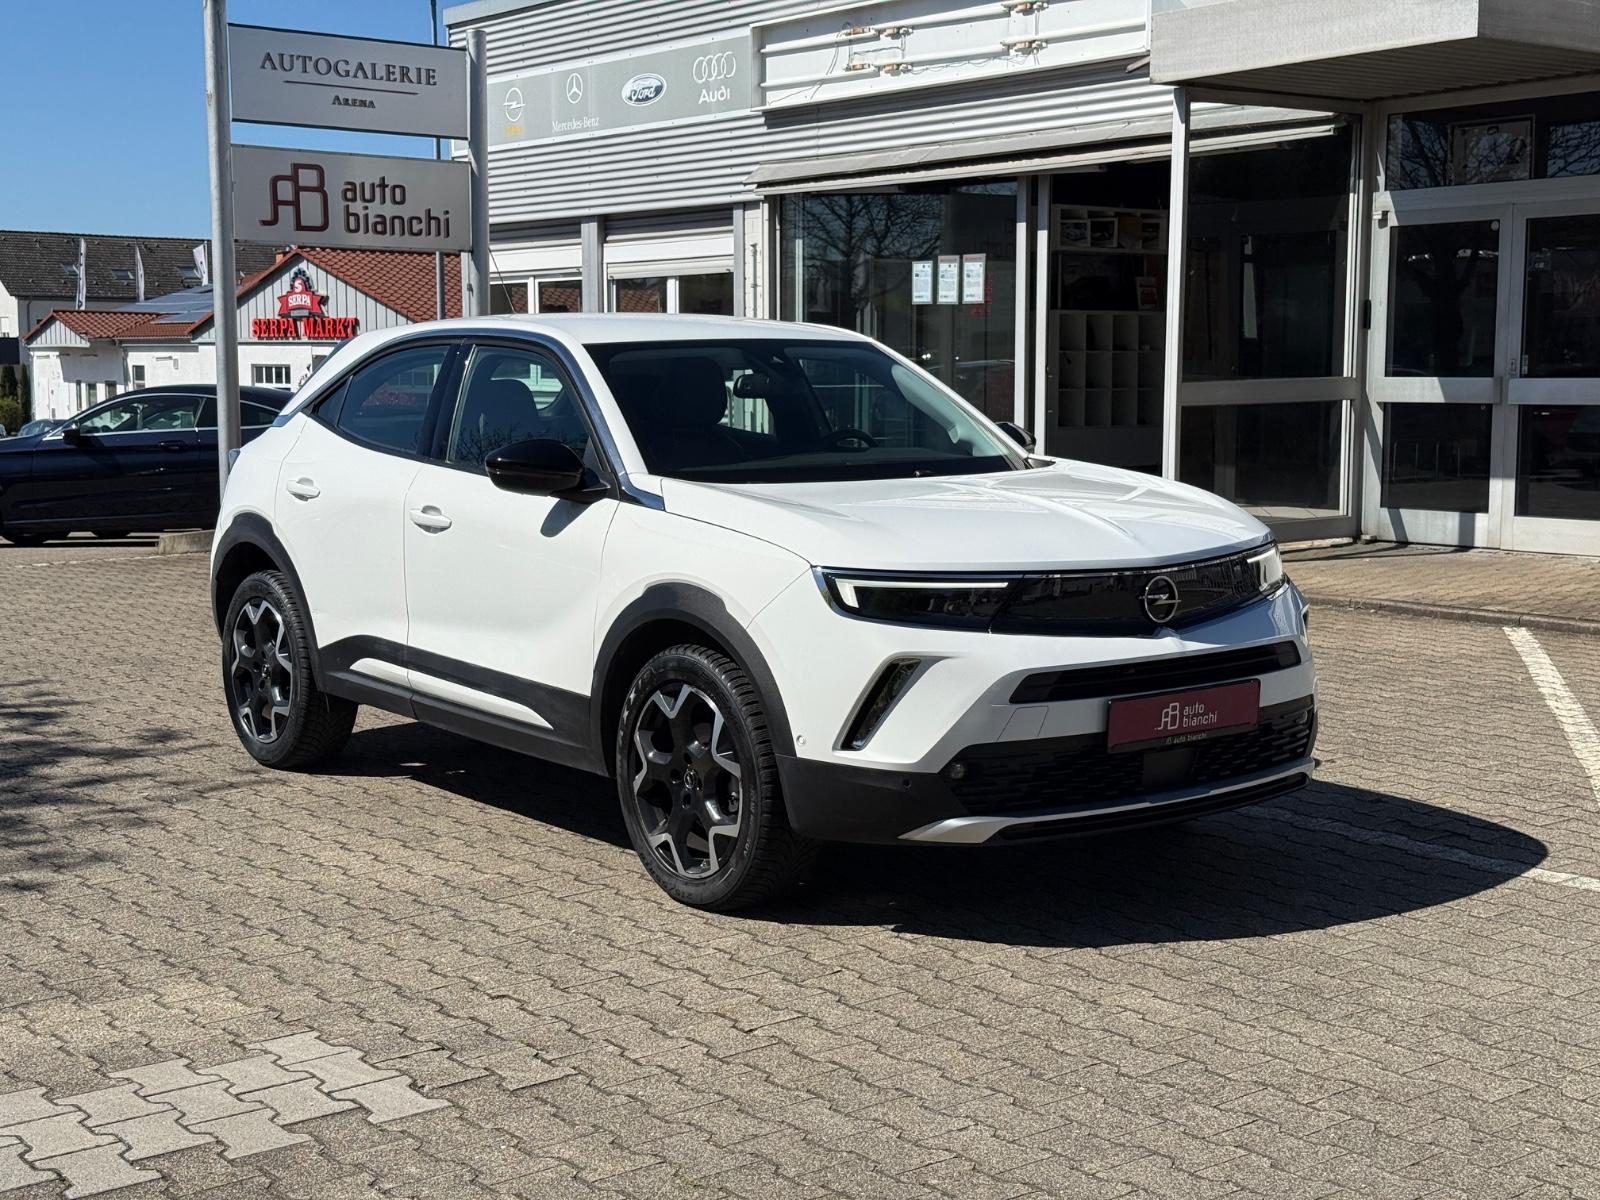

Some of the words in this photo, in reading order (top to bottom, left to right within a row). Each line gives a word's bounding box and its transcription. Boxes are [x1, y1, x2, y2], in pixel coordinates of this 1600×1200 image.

[260, 51, 437, 86] AUTOGALERIE
[628, 85, 657, 103] Ford
[698, 86, 730, 104] Audi
[552, 116, 600, 133] Mercedes-Benz
[341, 176, 407, 206] auto
[343, 205, 451, 239] bianchi
[288, 294, 311, 307] SERPA
[252, 318, 297, 338] SERPA
[303, 317, 357, 338] MARKT
[1183, 701, 1205, 716] auto
[1182, 710, 1218, 728] bianchi
[1173, 735, 1186, 744] auto
